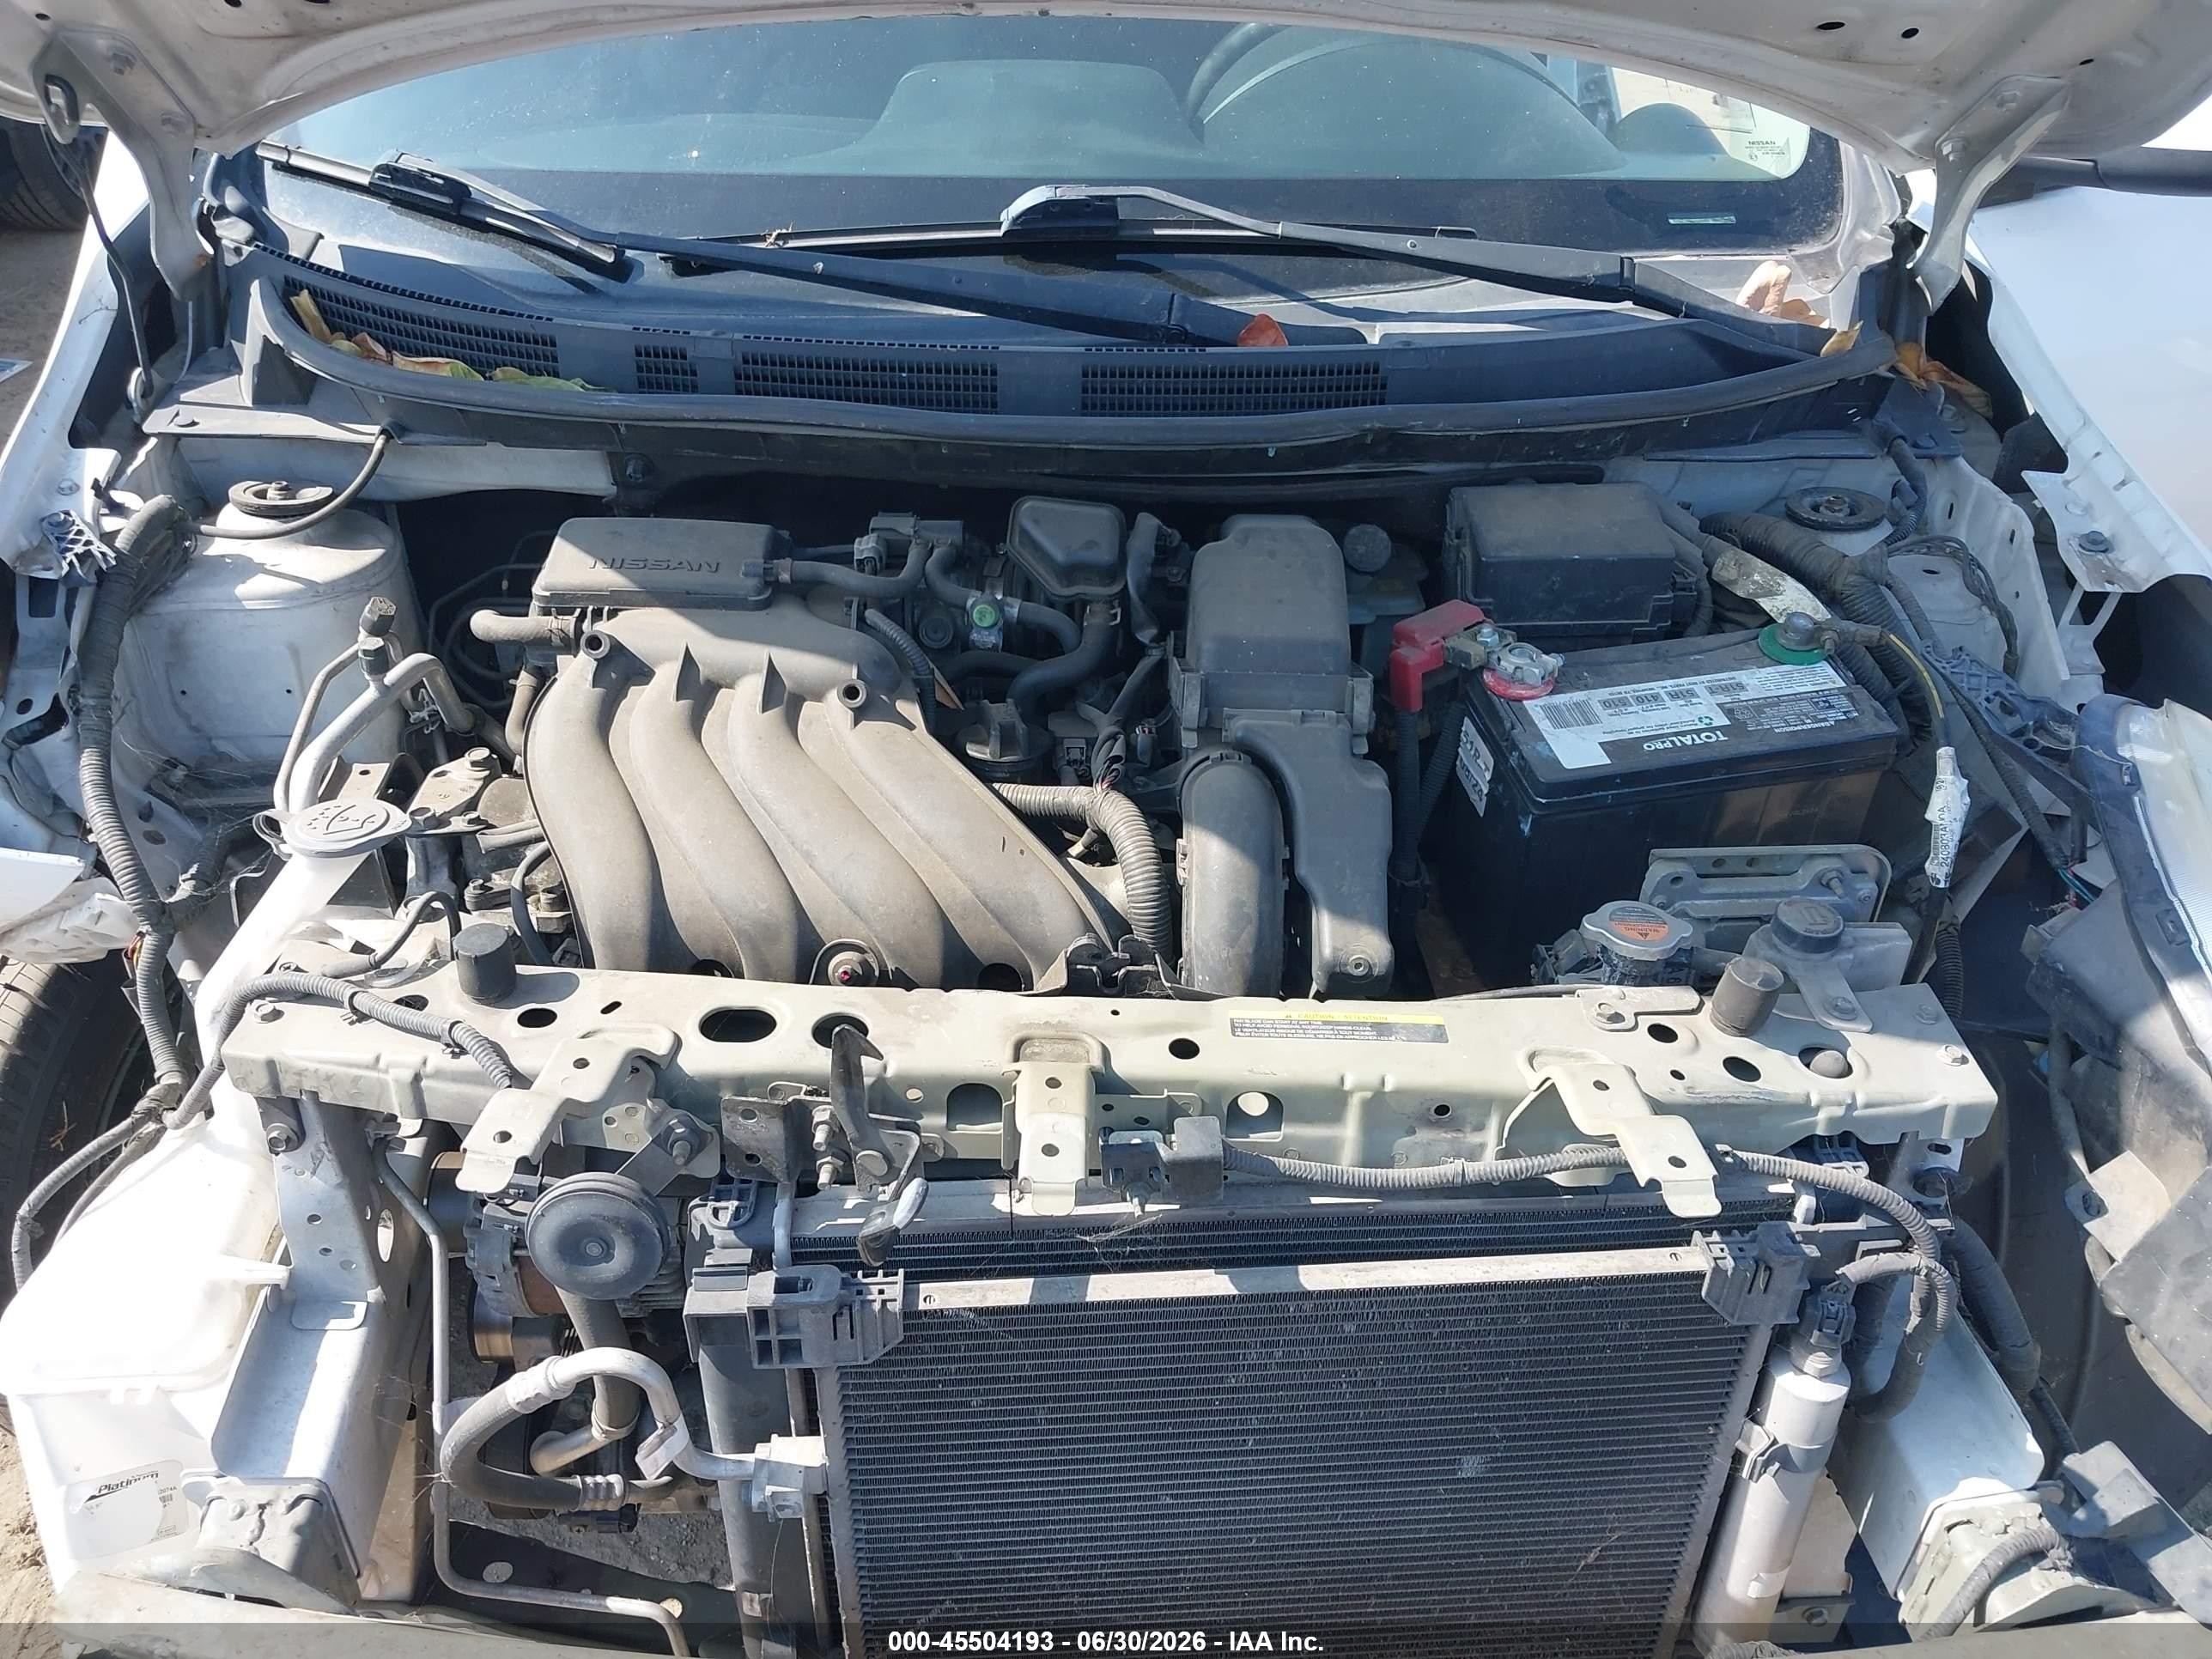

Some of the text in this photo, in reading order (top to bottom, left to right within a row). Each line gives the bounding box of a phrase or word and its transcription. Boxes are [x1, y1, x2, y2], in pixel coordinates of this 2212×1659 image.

[588, 557, 721, 573] NISSAN
[1635, 691, 1659, 704] 410
[1668, 688, 1696, 701] 51R
[1602, 698, 1627, 709] 510
[1643, 731, 1729, 751] TOTALPRO
[1462, 730, 1490, 778] 51R-T
[98, 1472, 158, 1494] Platinum
